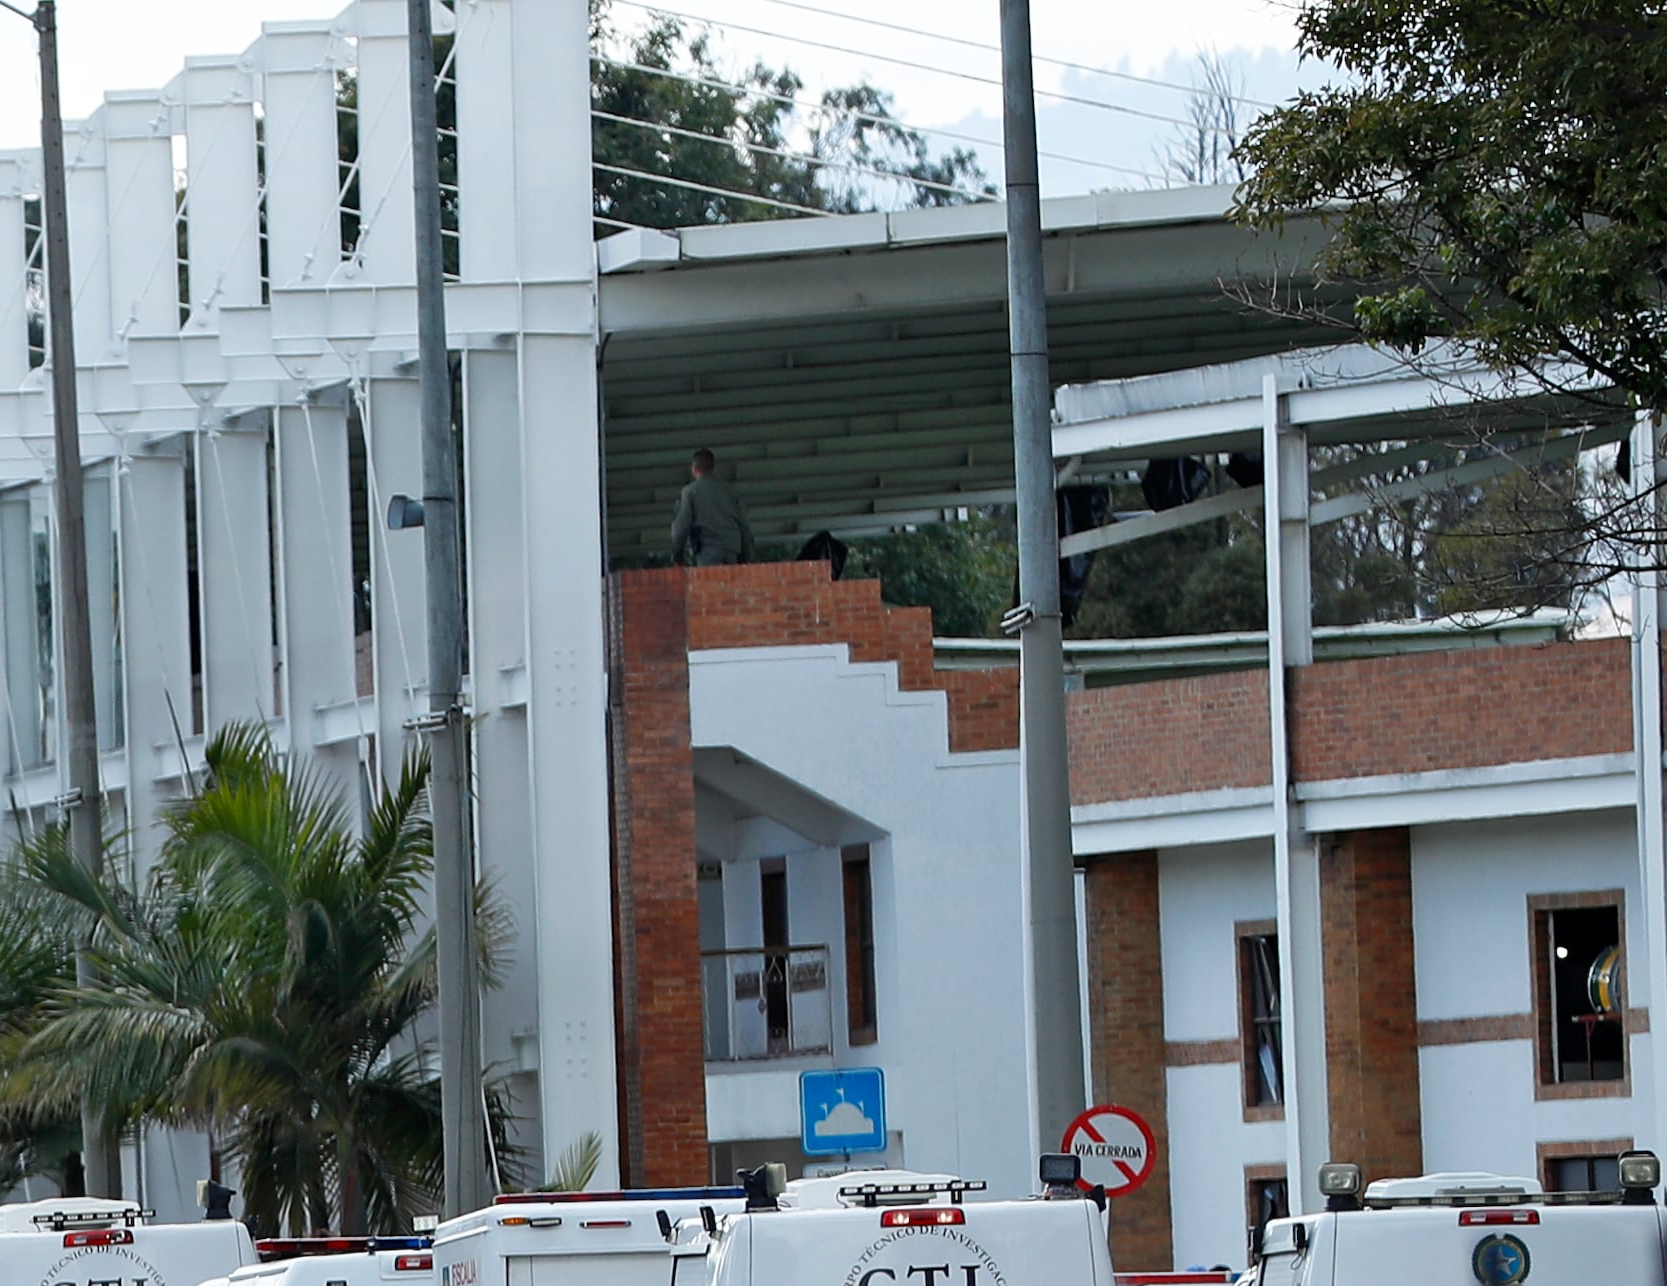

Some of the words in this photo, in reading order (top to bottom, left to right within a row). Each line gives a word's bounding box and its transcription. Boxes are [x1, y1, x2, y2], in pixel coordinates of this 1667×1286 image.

[1075, 1143, 1093, 1156] VIA
[1096, 1144, 1142, 1158] CERRADA
[919, 1226, 939, 1236] DE
[97, 1245, 113, 1254] DE
